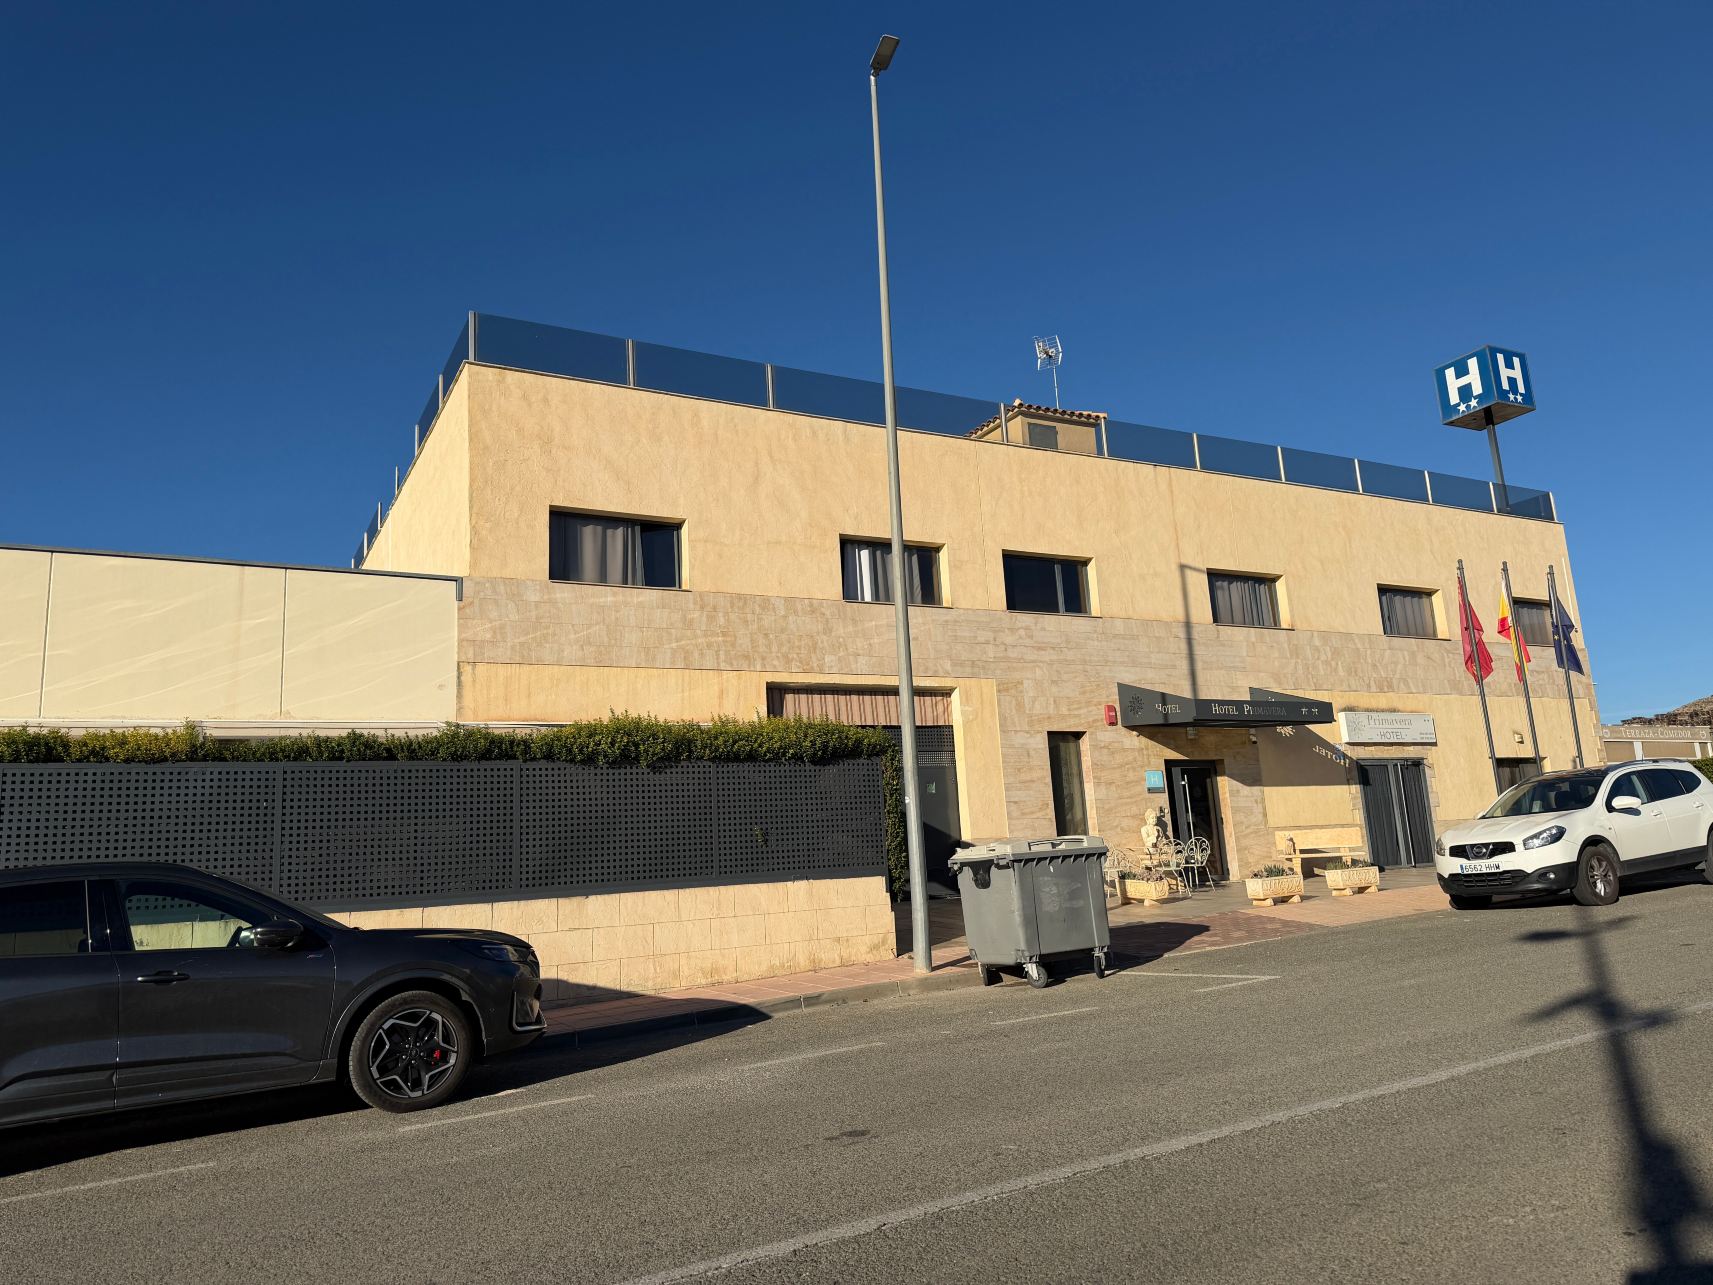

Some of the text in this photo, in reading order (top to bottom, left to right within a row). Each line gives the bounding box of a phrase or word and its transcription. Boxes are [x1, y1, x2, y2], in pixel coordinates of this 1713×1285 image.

[1496, 352, 1526, 394] H
[1444, 356, 1483, 406] H
[1211, 703, 1287, 716] HOTEL PRIMAVERA
[1367, 714, 1413, 726] Primavera
[1379, 731, 1406, 740] HOTEL
[1619, 727, 1692, 739] TERRAZA-COMEDOR
[1150, 774, 1159, 786] H
